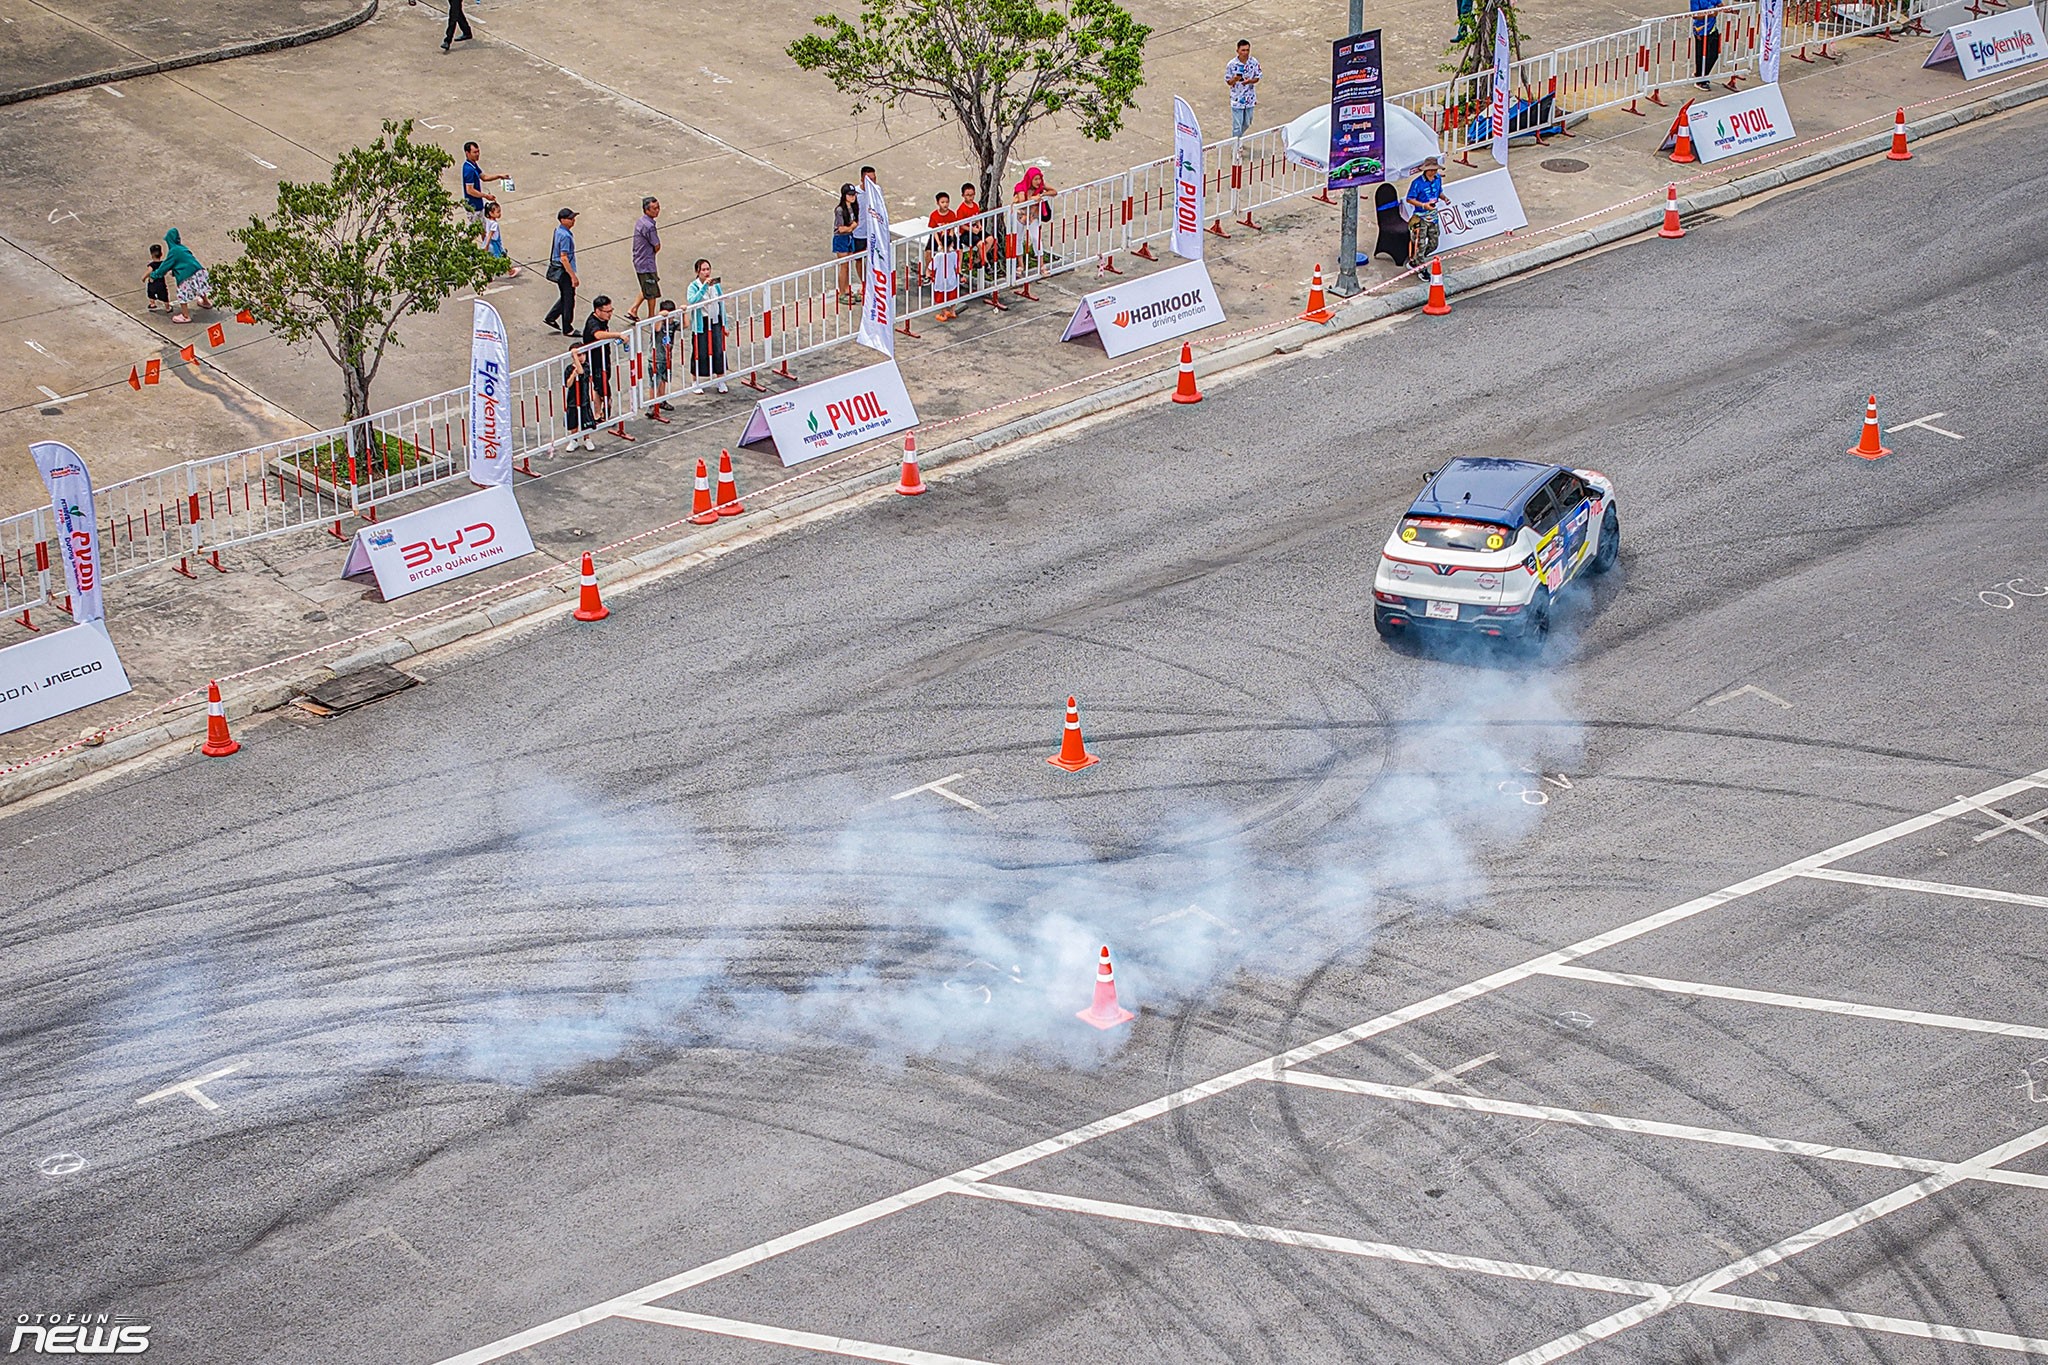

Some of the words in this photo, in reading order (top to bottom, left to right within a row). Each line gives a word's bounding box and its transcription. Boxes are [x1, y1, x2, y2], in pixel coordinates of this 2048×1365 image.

[1969, 29, 2035, 66] Ekokemika
[1729, 107, 1774, 138] PVOIL
[1178, 181, 1197, 233] PVOIL
[1151, 314, 1177, 328] driving
[1177, 304, 1206, 320] emotion
[477, 360, 499, 460] Ekokemika
[826, 391, 888, 431] PVOIL
[400, 522, 496, 569] BYD
[409, 565, 443, 582] BITCAR
[480, 546, 504, 559] NINH
[42, 661, 103, 688] JAECOO
